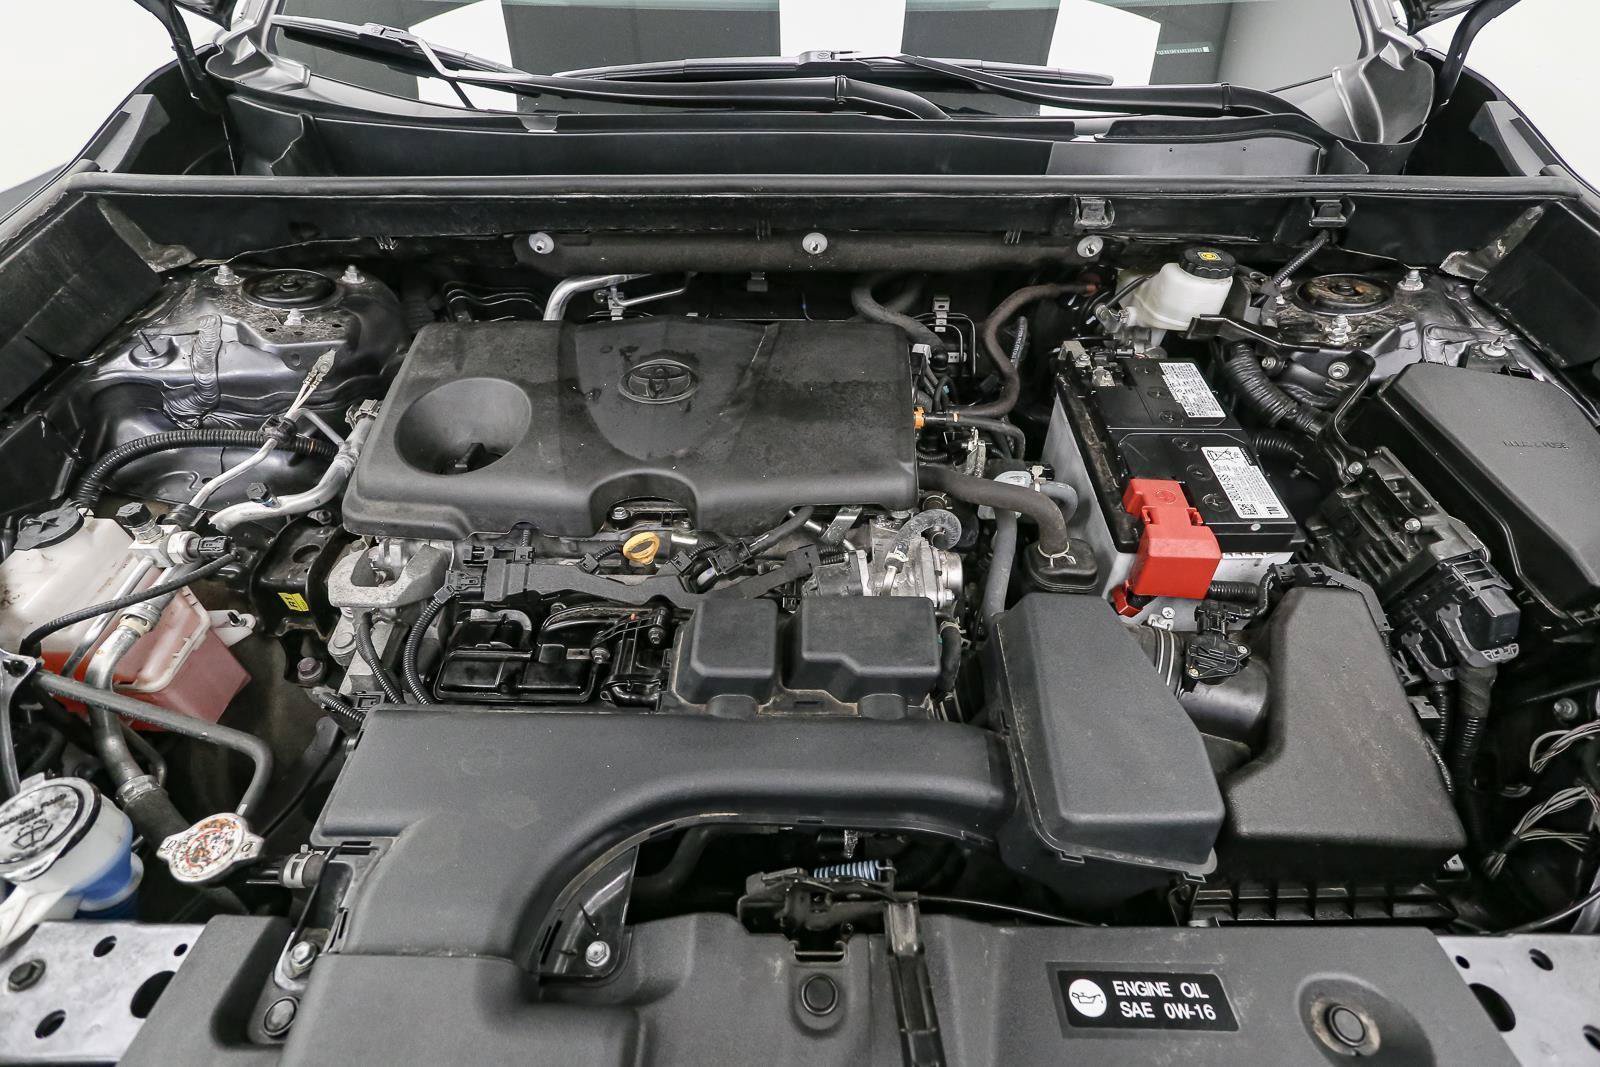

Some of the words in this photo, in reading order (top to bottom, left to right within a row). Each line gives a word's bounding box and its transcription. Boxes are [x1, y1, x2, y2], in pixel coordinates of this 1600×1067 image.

[1112, 980, 1173, 998] ENGINE
[1180, 982, 1210, 999] OIL
[1120, 1001, 1156, 1019] SAE
[1164, 1002, 1217, 1021] 0W-16
